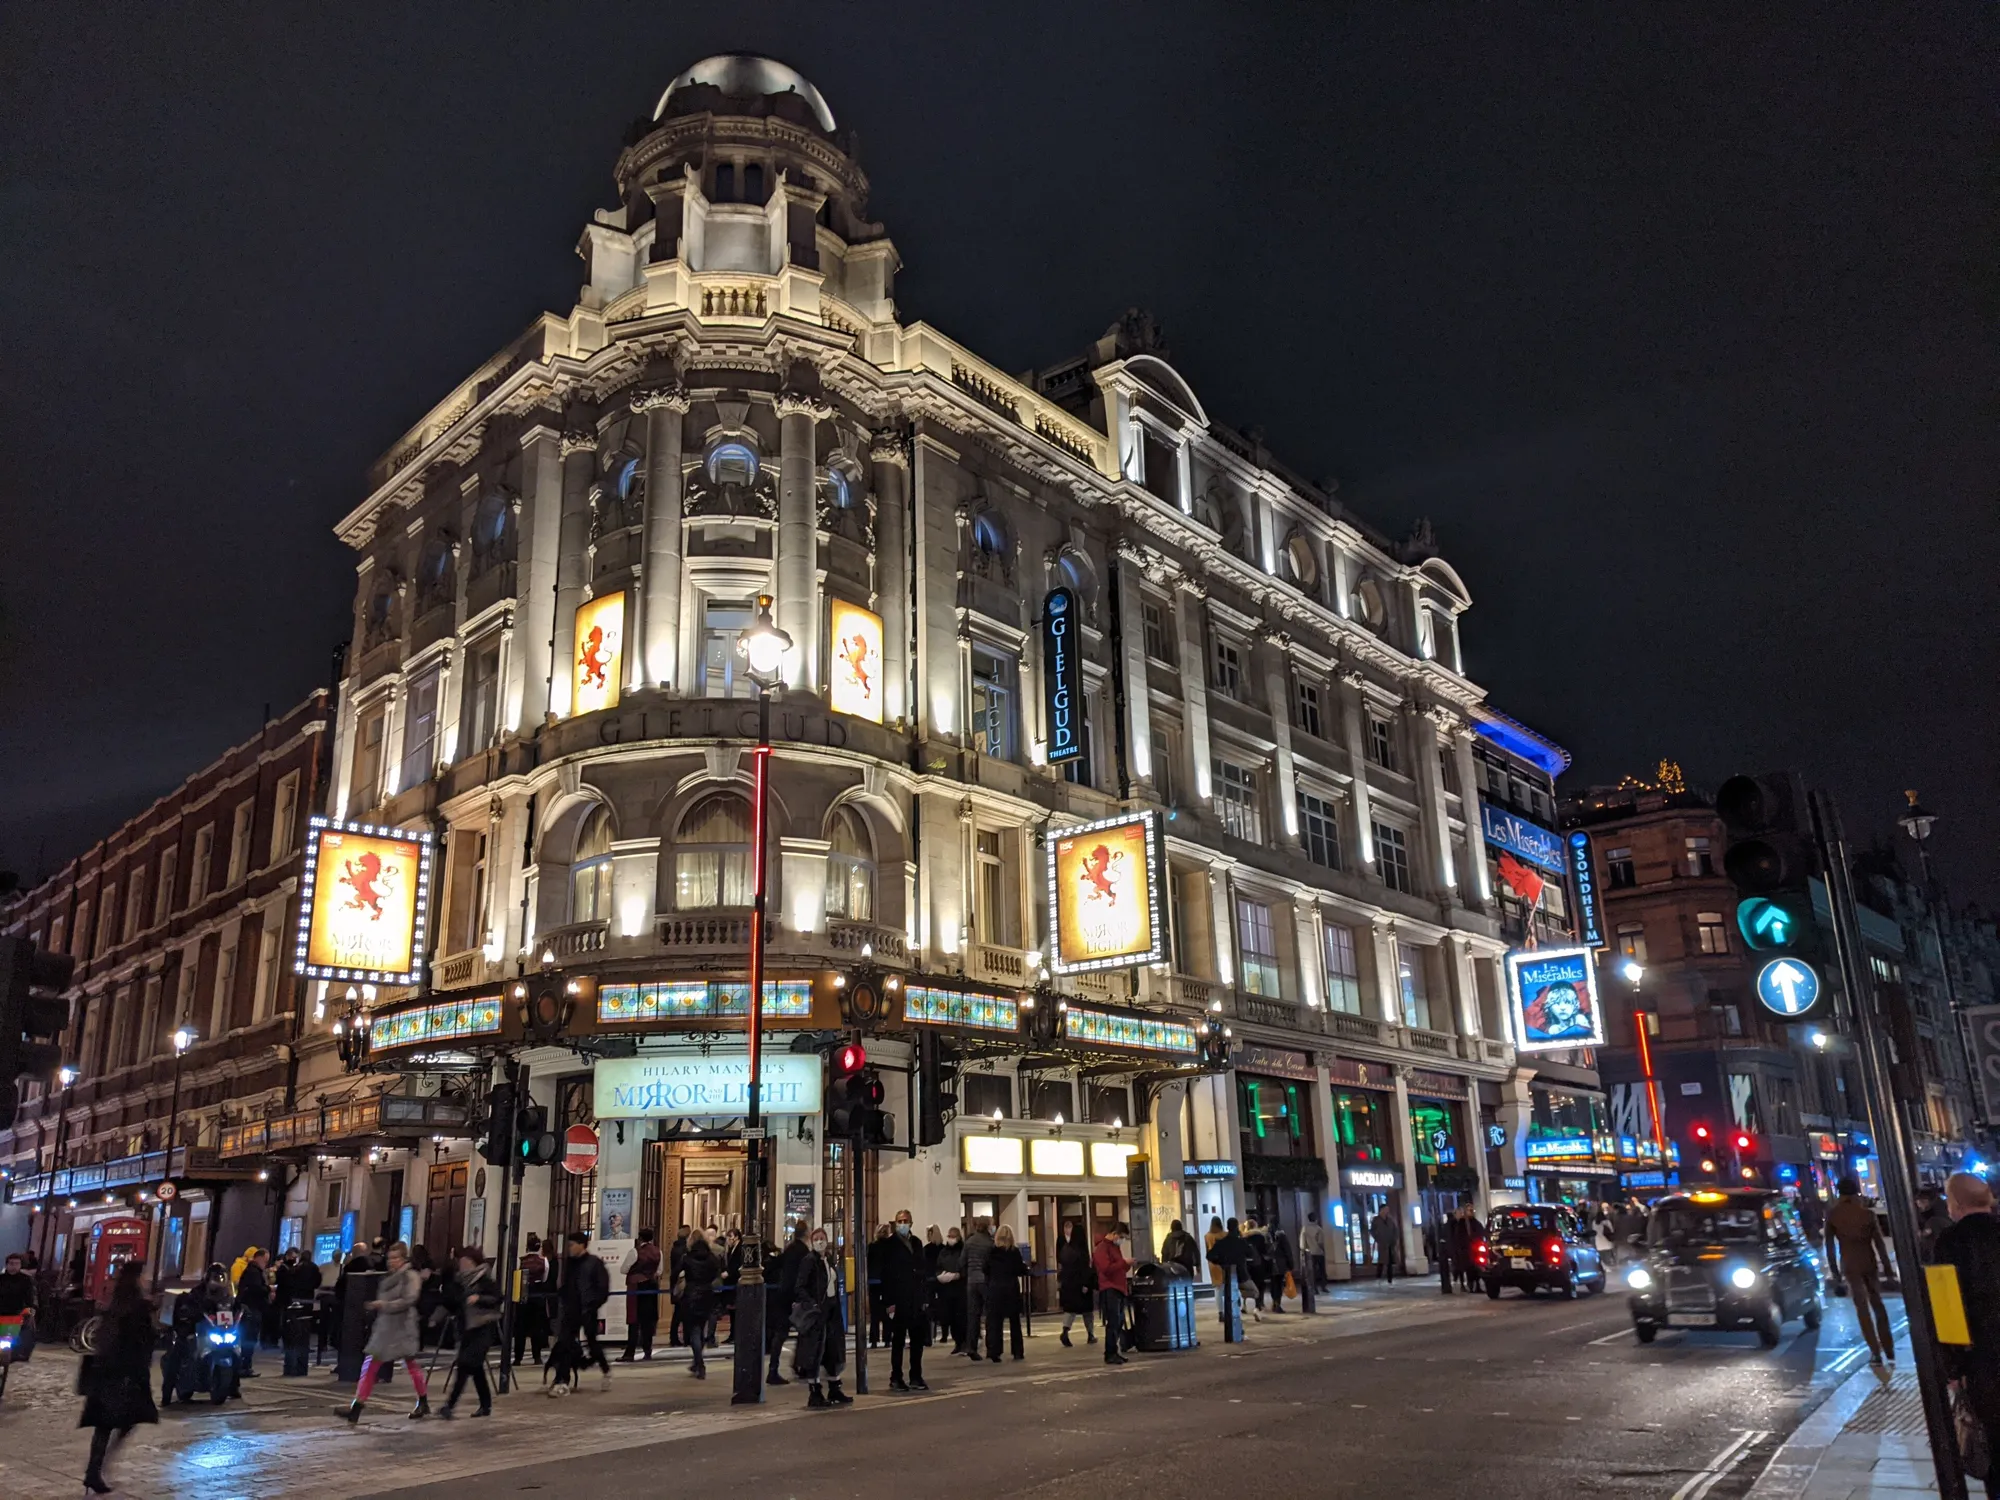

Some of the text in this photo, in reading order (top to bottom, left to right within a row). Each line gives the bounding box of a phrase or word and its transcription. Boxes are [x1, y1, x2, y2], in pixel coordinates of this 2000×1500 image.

[1052, 617, 1071, 747] GIELGUD
[598, 708, 848, 746] GIELGUD
[1049, 745, 1078, 759] THEATRE
[1484, 807, 1507, 843] Les
[1577, 848, 1599, 941] SONDHEIM
[1086, 935, 1125, 954] LIGHT
[333, 949, 385, 968] LIGHT
[643, 1065, 702, 1076] HILARY
[613, 1080, 711, 1110] MIRROR
[161, 1187, 173, 1195] 20
[221, 1312, 230, 1322] L
